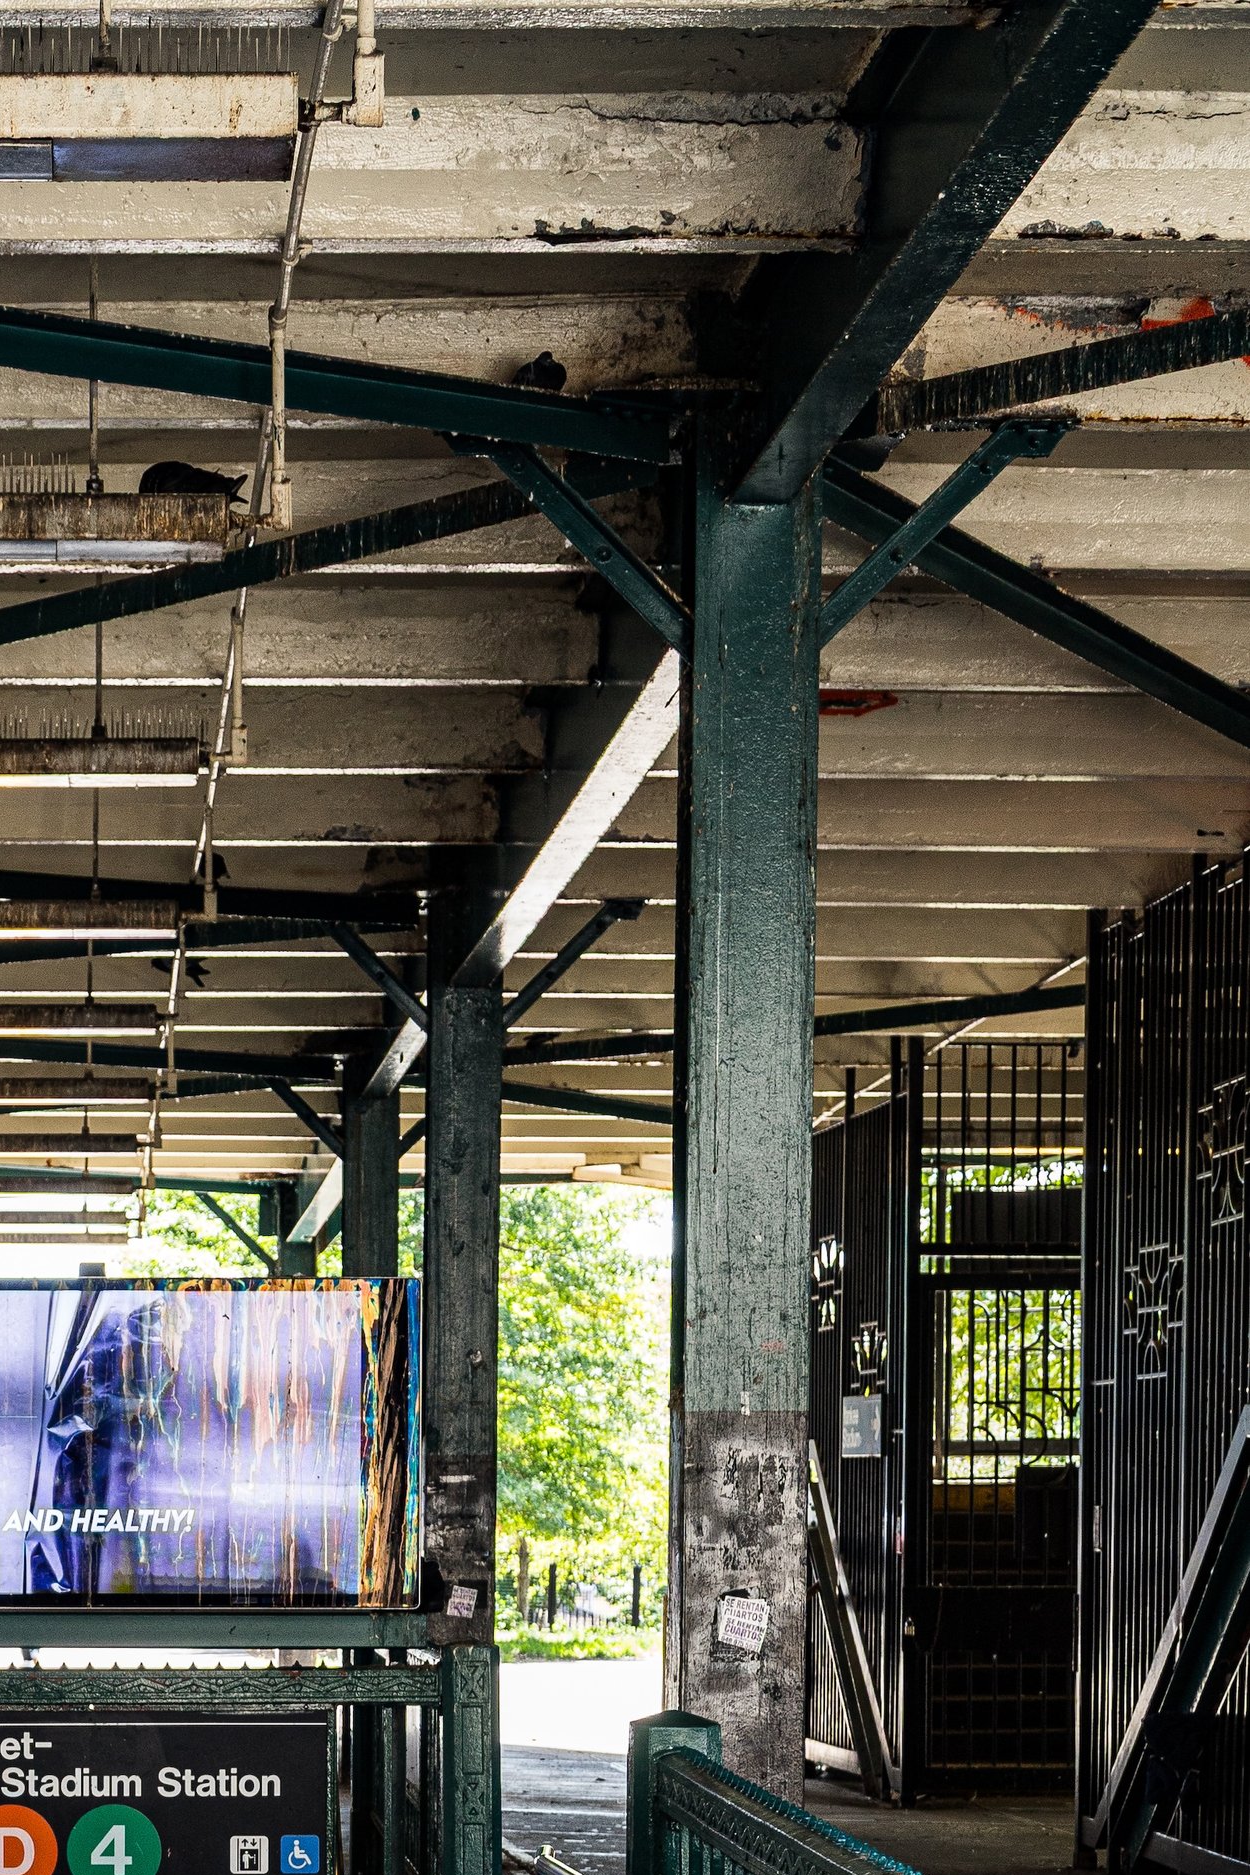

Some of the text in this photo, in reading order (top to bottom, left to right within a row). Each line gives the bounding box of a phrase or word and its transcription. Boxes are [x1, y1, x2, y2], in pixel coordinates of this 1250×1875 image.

[2, 1509, 64, 1532] AND
[70, 1508, 195, 1533] HEALTHY!
[725, 1598, 766, 1613] SE RENTAN
[724, 1623, 763, 1642] CUARTOS
[0, 1766, 142, 1798] Stadium
[157, 1766, 281, 1798] Station
[90, 1824, 133, 1875] 4
